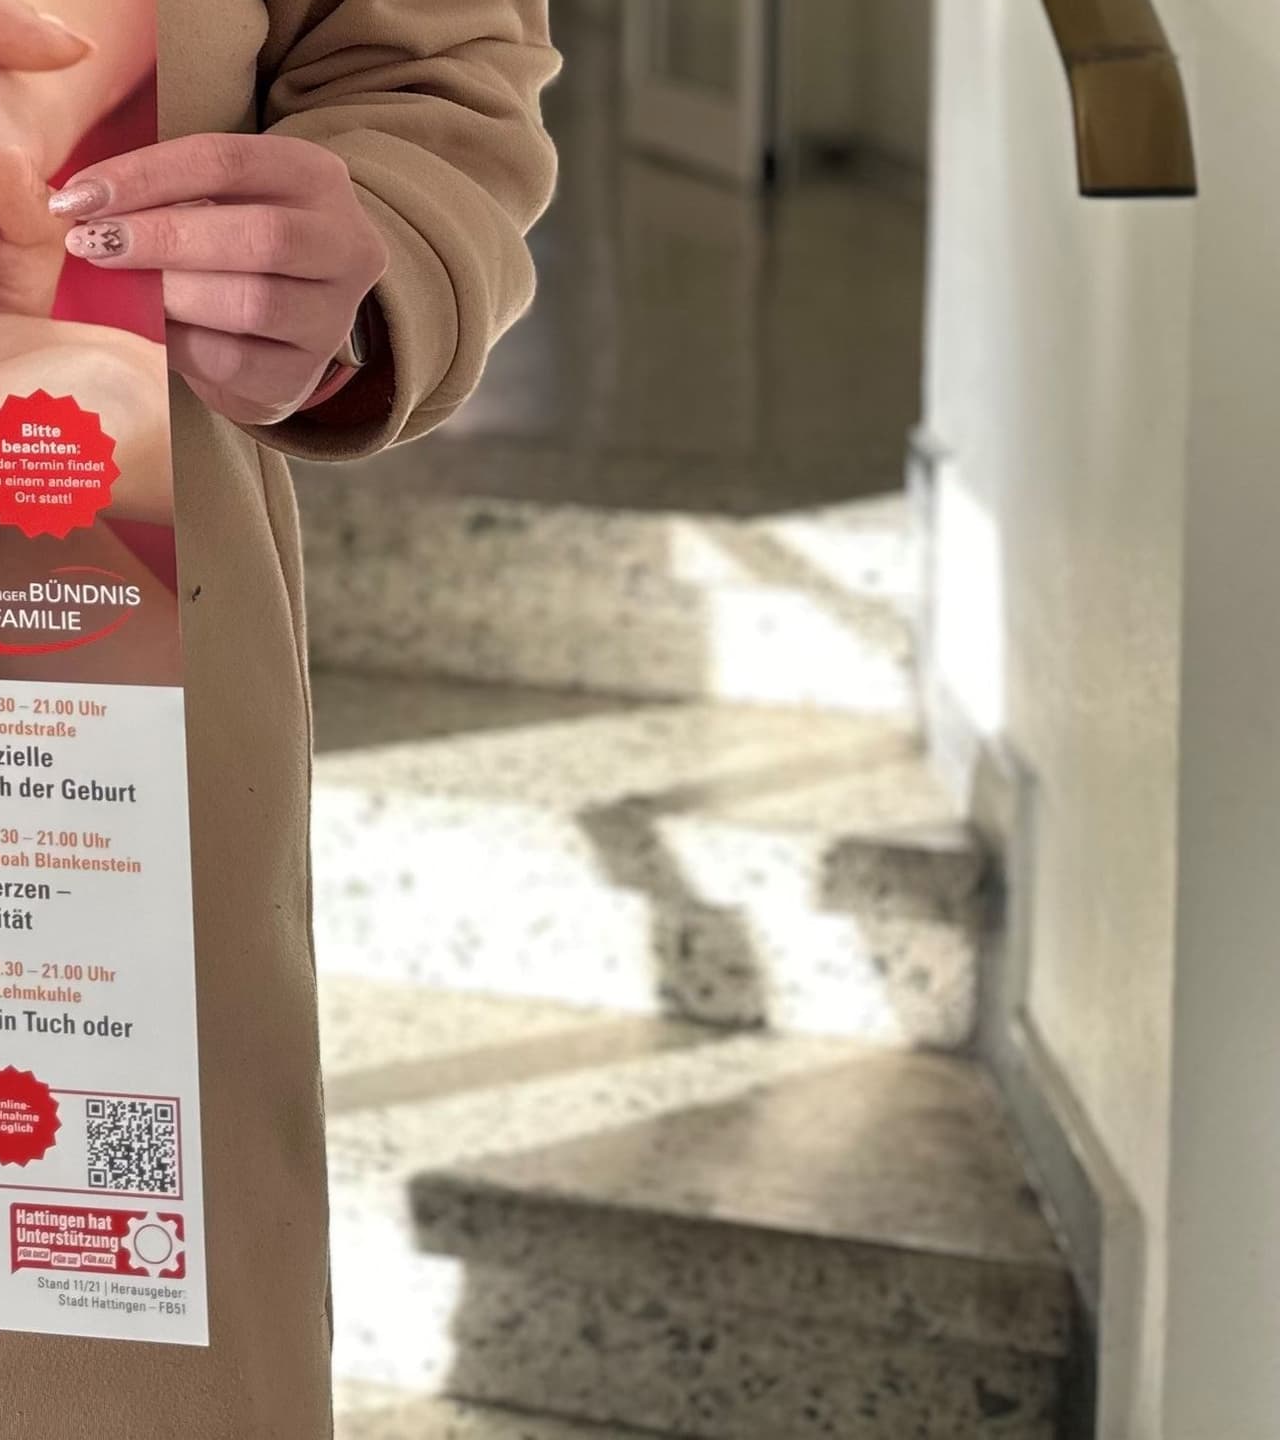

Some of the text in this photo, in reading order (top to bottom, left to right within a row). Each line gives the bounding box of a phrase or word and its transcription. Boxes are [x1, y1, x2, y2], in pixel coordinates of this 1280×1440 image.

[22, 423, 61, 438] Bitte
[1, 440, 81, 455] beachten:
[19, 459, 64, 471] Termin
[67, 460, 104, 472] findet
[5, 476, 45, 488] einem
[48, 477, 101, 489] anderen
[15, 492, 72, 505] Ort statt!
[29, 579, 141, 606] BÜNDNIS
[33, 698, 73, 715] 21.00
[78, 700, 107, 717] Uhr
[19, 777, 54, 800] der
[61, 779, 136, 803] Geburt
[35, 853, 141, 873] Blankenstein
[23, 1011, 76, 1034] Tuch
[83, 1016, 133, 1038] oder
[16, 1209, 112, 1231] Hattingen hat
[16, 1227, 119, 1253] Unterstützung
[38, 1276, 187, 1300] Stand 11/21 Herausgeber:
[59, 1294, 187, 1315] Stadt Hattingen FB51
